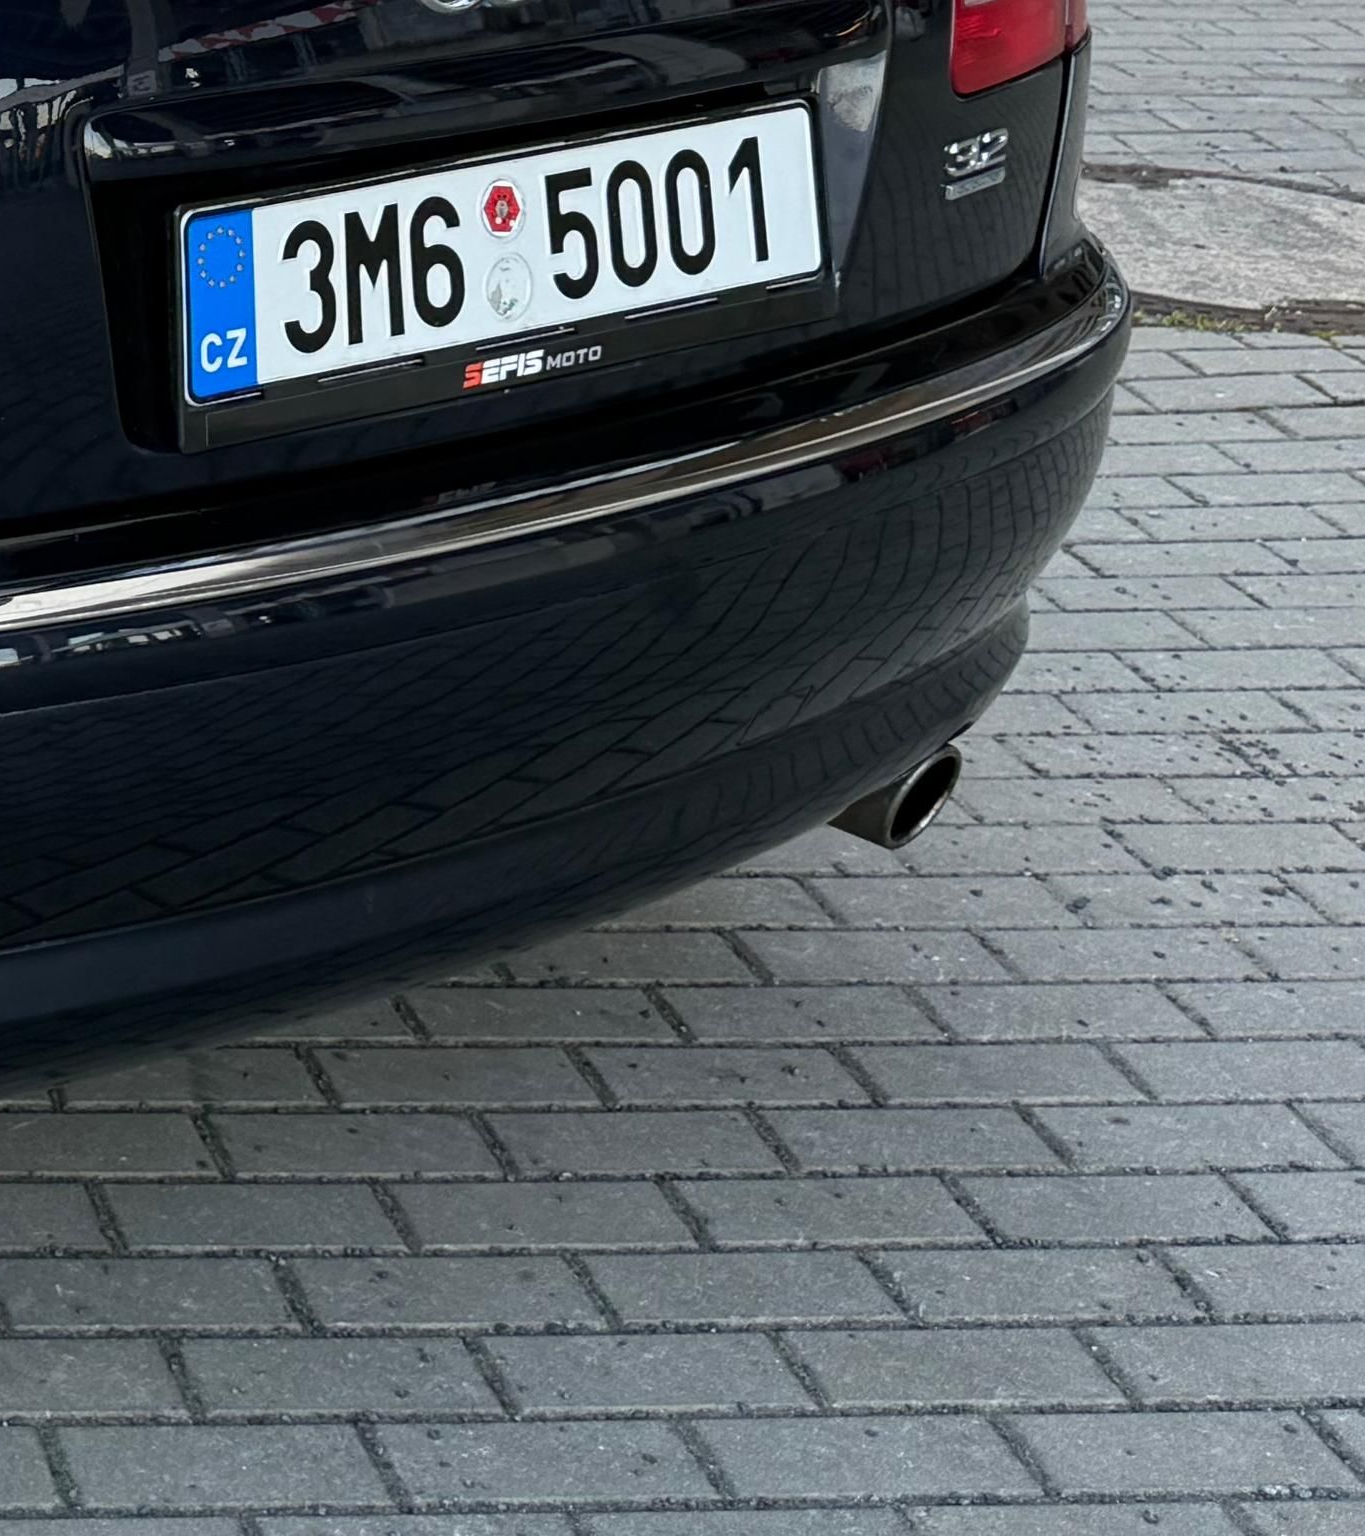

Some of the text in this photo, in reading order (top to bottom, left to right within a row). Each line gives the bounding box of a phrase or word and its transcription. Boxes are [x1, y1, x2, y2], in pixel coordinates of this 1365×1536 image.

[282, 135, 770, 354] 3M6 5001
[199, 327, 248, 373] CZ
[462, 345, 603, 390] SEFIS MOTO
